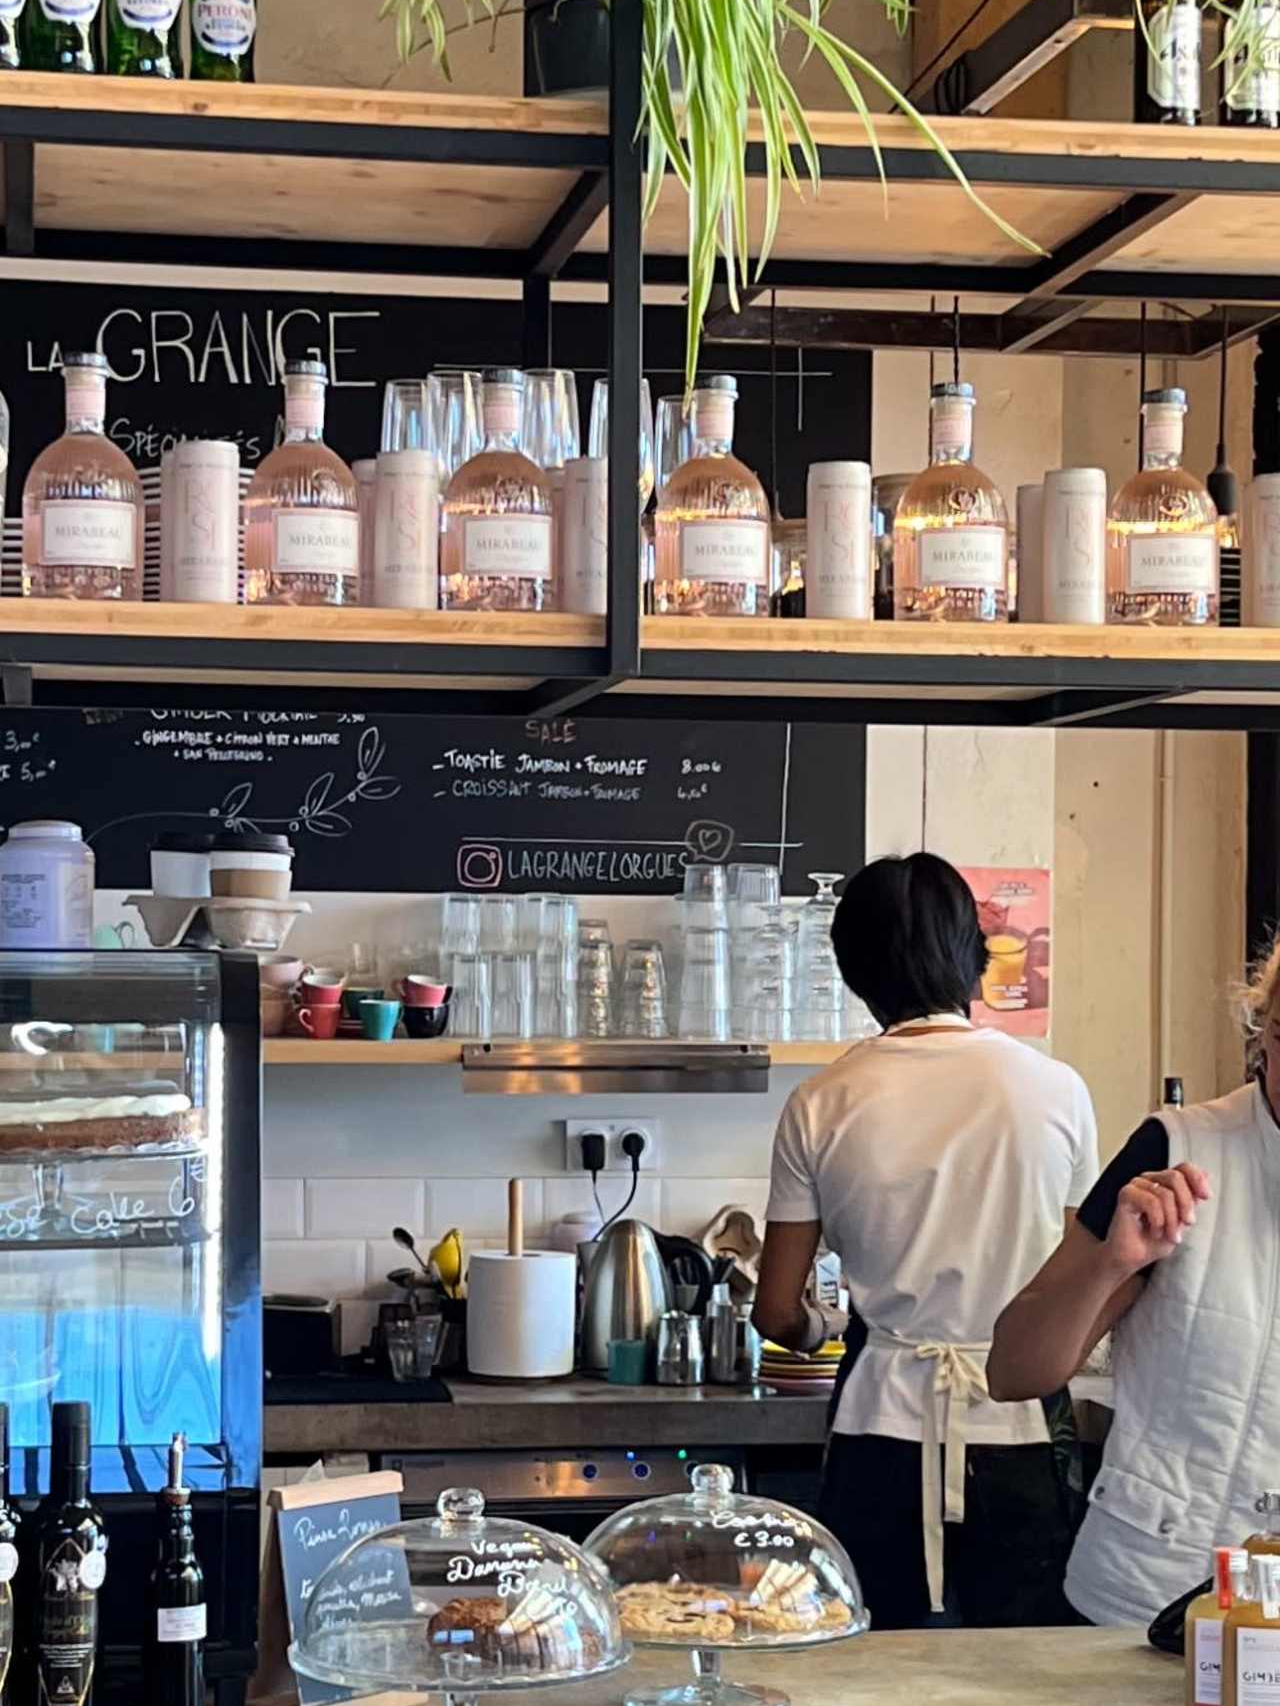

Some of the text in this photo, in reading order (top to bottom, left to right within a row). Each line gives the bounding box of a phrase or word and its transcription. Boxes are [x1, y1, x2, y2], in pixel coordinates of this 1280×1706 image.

[97, 309, 381, 387] GRANGE
[444, 749, 506, 773] TOASTIE
[515, 754, 570, 774] JAMBON
[583, 754, 648, 776] FROMAGE
[452, 779, 532, 797] CROISSANT
